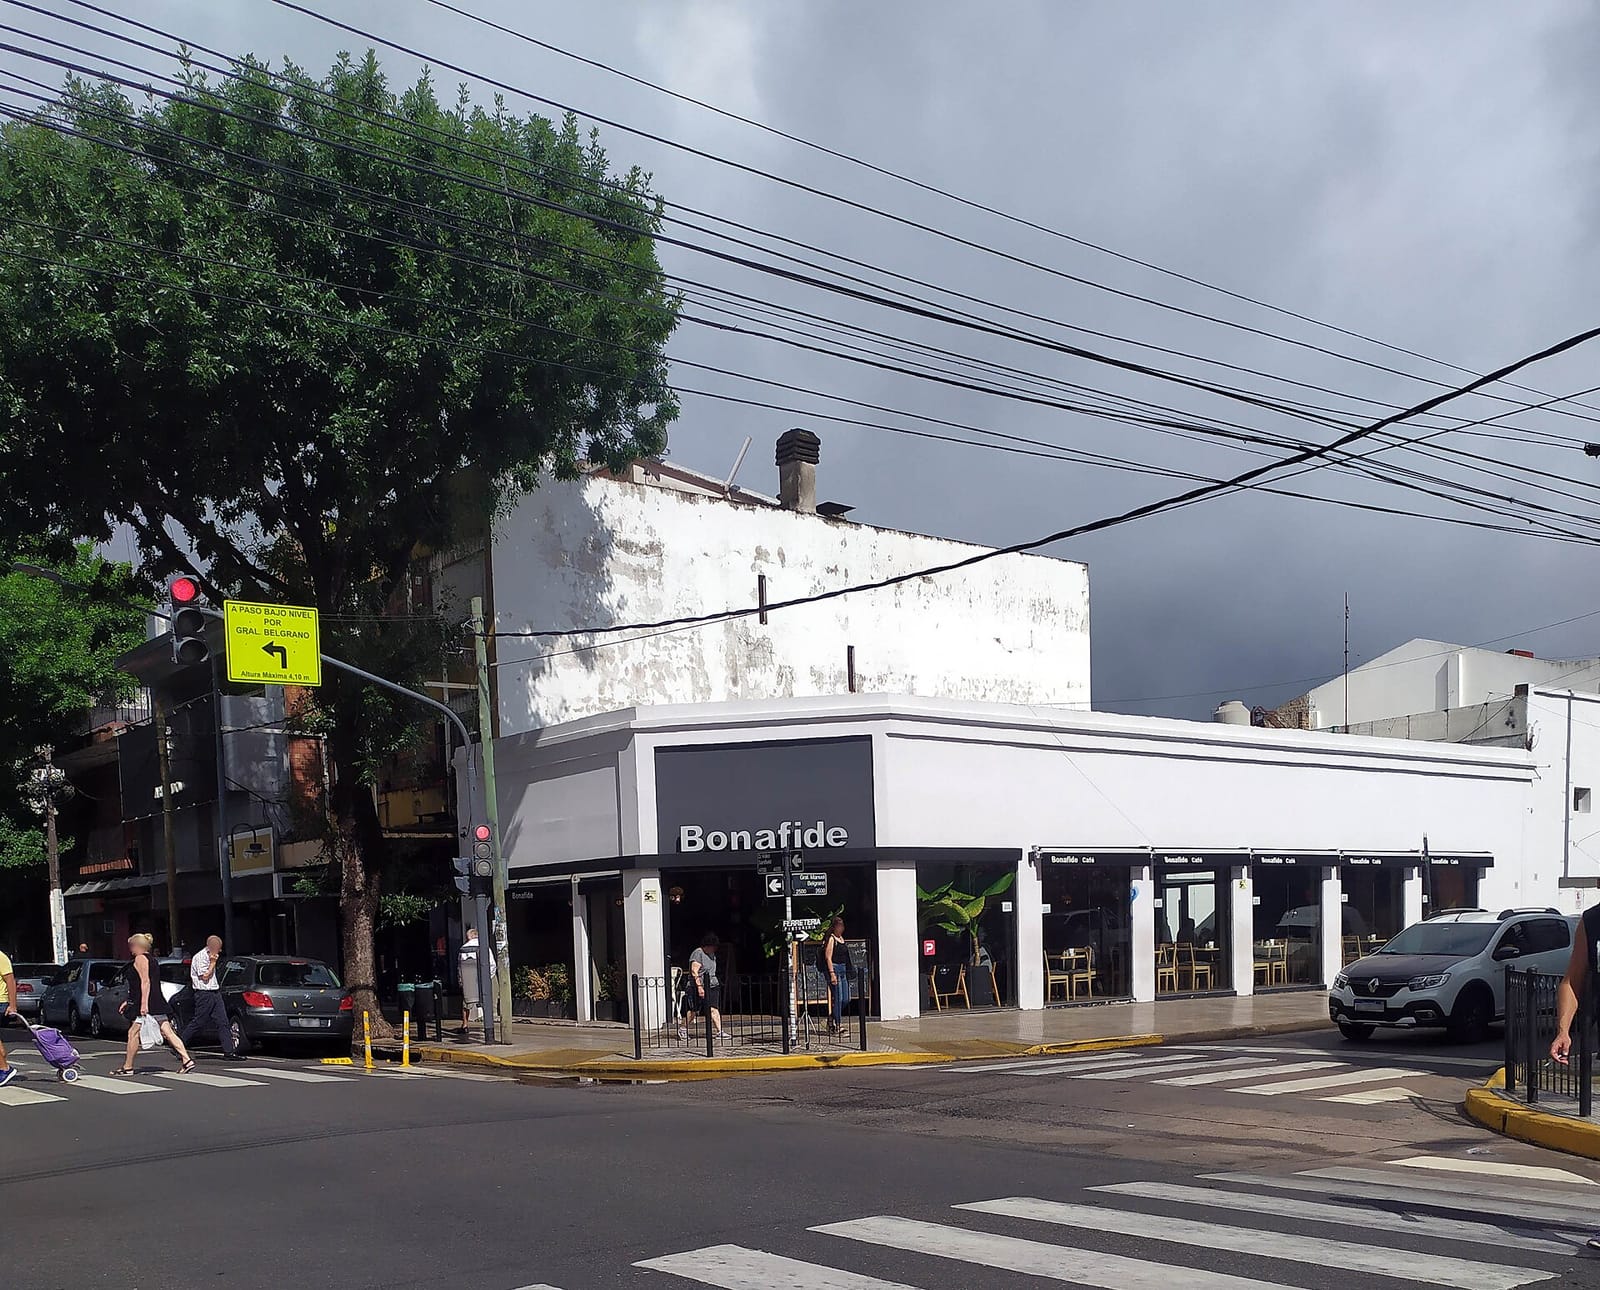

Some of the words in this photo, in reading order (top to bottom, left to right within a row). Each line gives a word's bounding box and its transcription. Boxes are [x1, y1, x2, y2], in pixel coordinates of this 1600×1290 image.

[239, 607, 262, 615] PASO
[263, 608, 287, 617] BAJO
[288, 610, 313, 619] NIVEL
[263, 618, 282, 627] POR
[263, 628, 310, 639] BELGRANO
[240, 670, 261, 678] Altura
[680, 821, 848, 852] Bonafide
[1051, 856, 1079, 864] Bonafide
[1164, 856, 1189, 864] Bonafide
[783, 918, 821, 927] FERRETERIA
